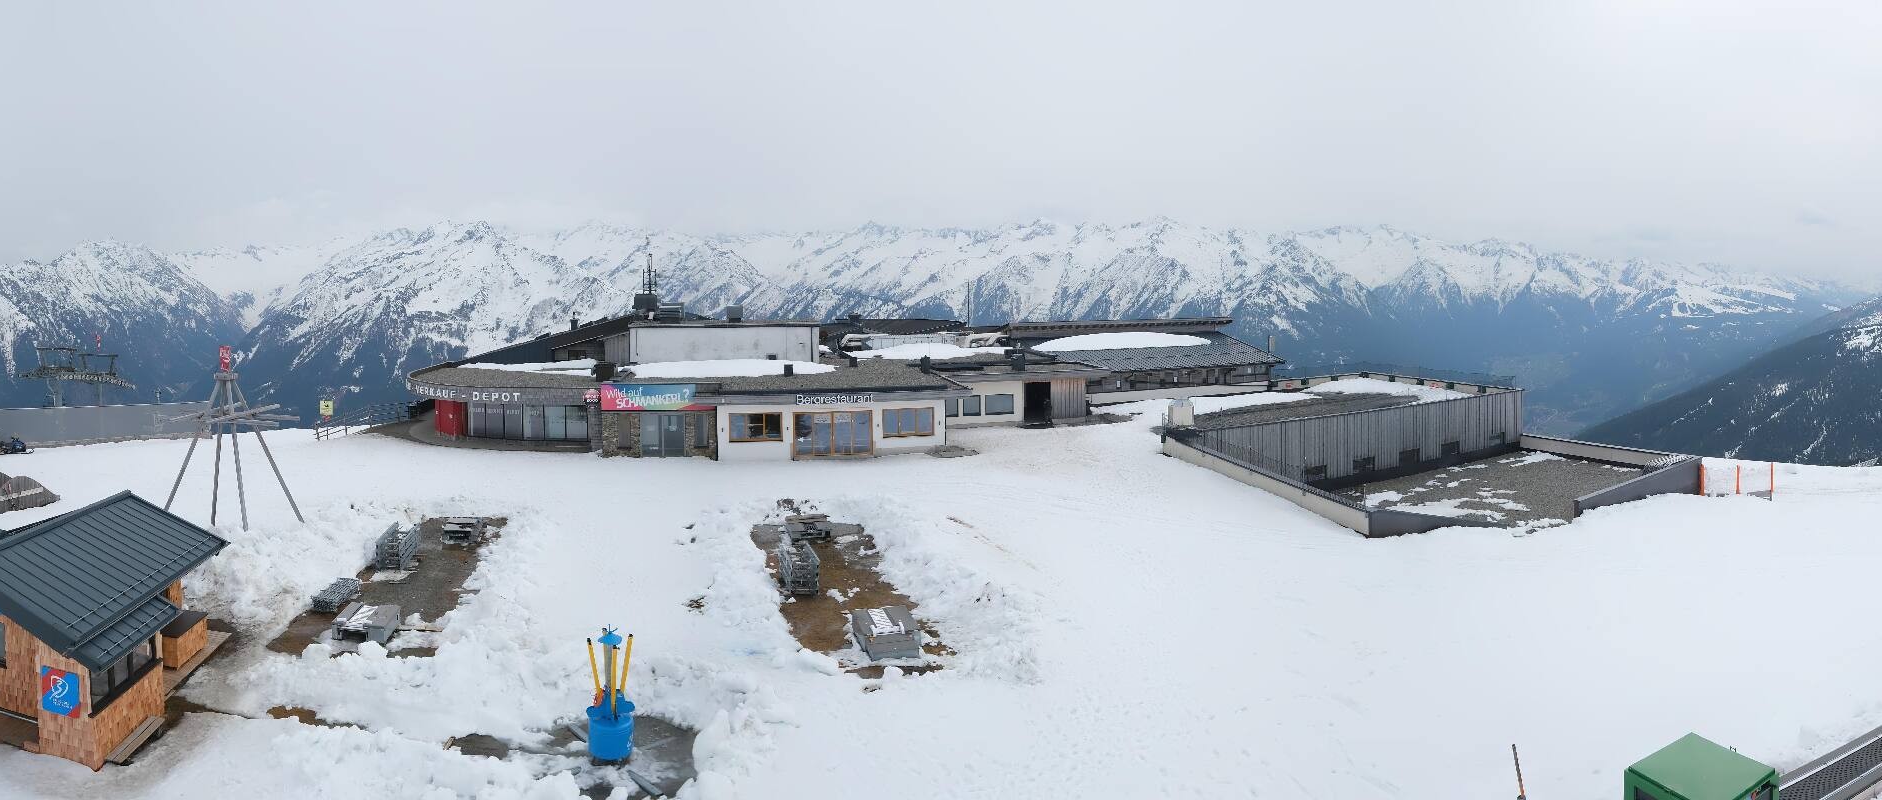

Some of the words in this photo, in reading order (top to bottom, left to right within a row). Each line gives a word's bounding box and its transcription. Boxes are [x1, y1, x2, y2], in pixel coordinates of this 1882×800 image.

[415, 384, 456, 398] VERKAUF
[472, 391, 521, 402] DEPOT
[606, 387, 626, 399] Wild
[628, 386, 643, 396] auf
[616, 388, 690, 409] SCHMANKERL?
[796, 394, 874, 405] Bergrestaurant
